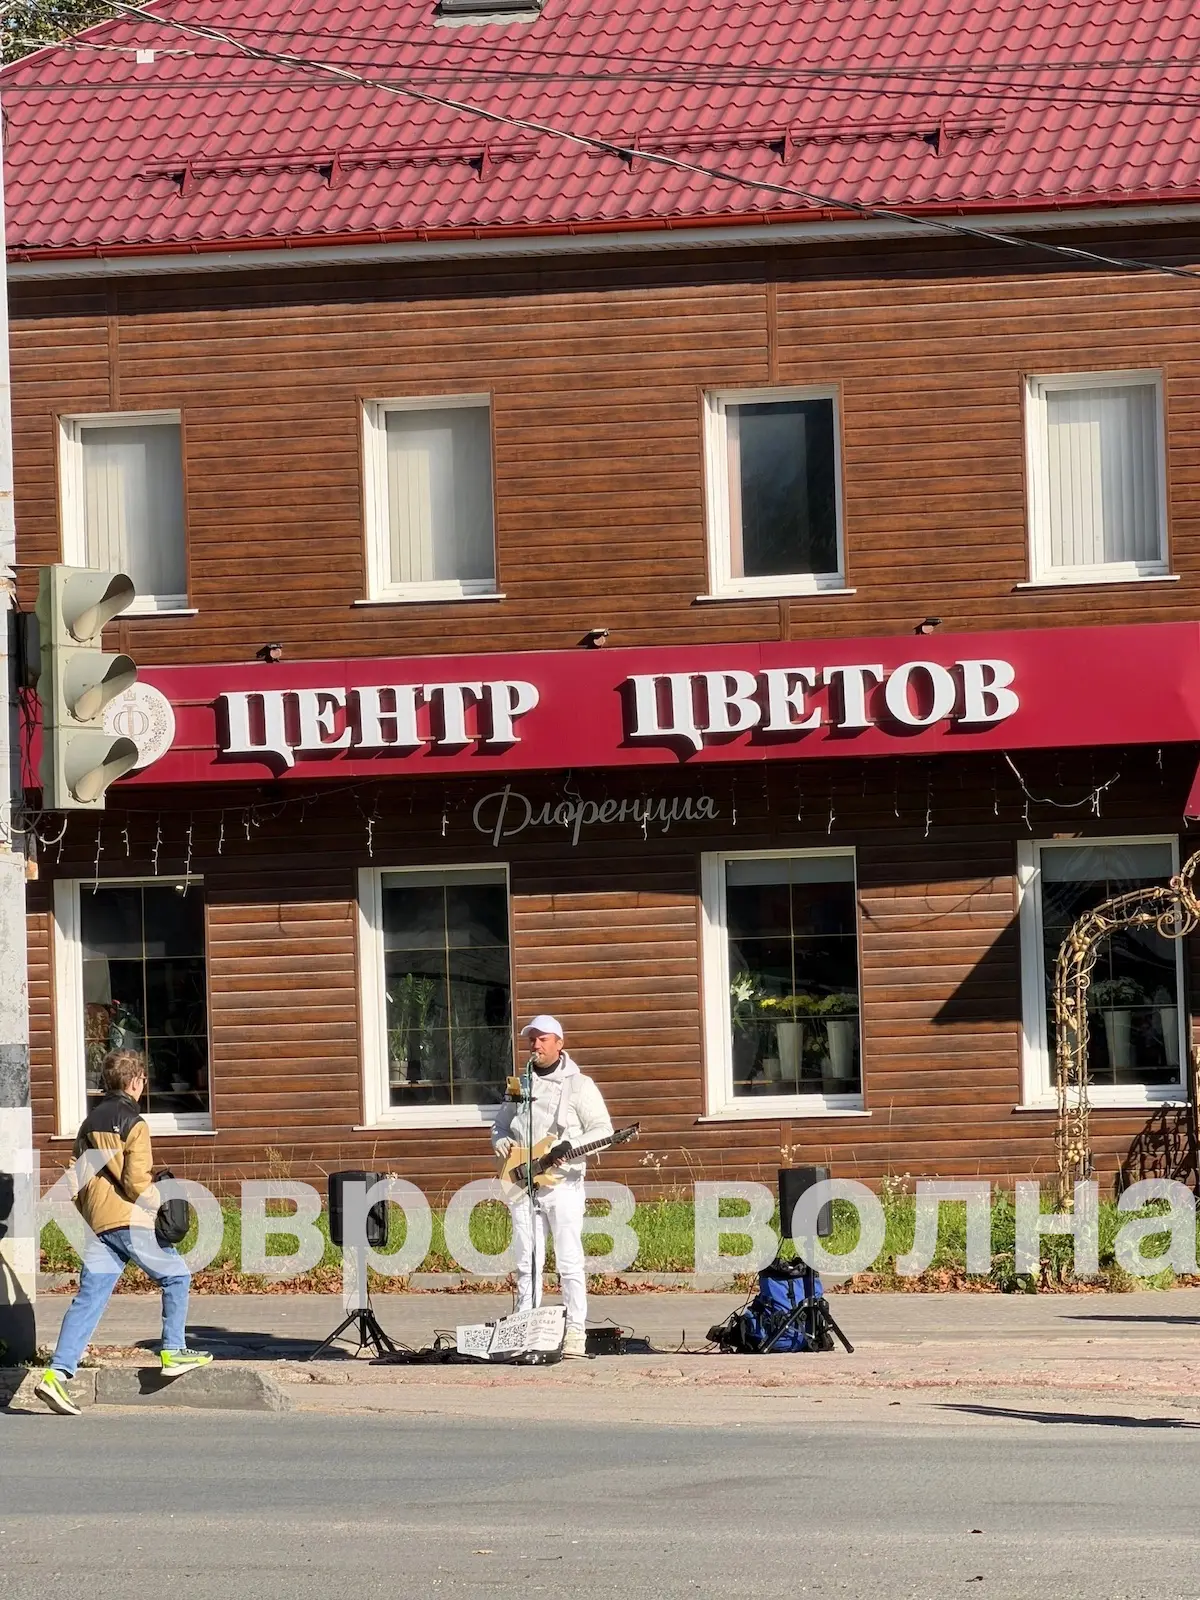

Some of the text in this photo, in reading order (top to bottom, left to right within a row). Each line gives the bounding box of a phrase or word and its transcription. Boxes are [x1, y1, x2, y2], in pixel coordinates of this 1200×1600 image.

[220, 659, 1020, 767] ЦЕНТР ЦВЕТОВ
[472, 784, 720, 847] Флоренция
